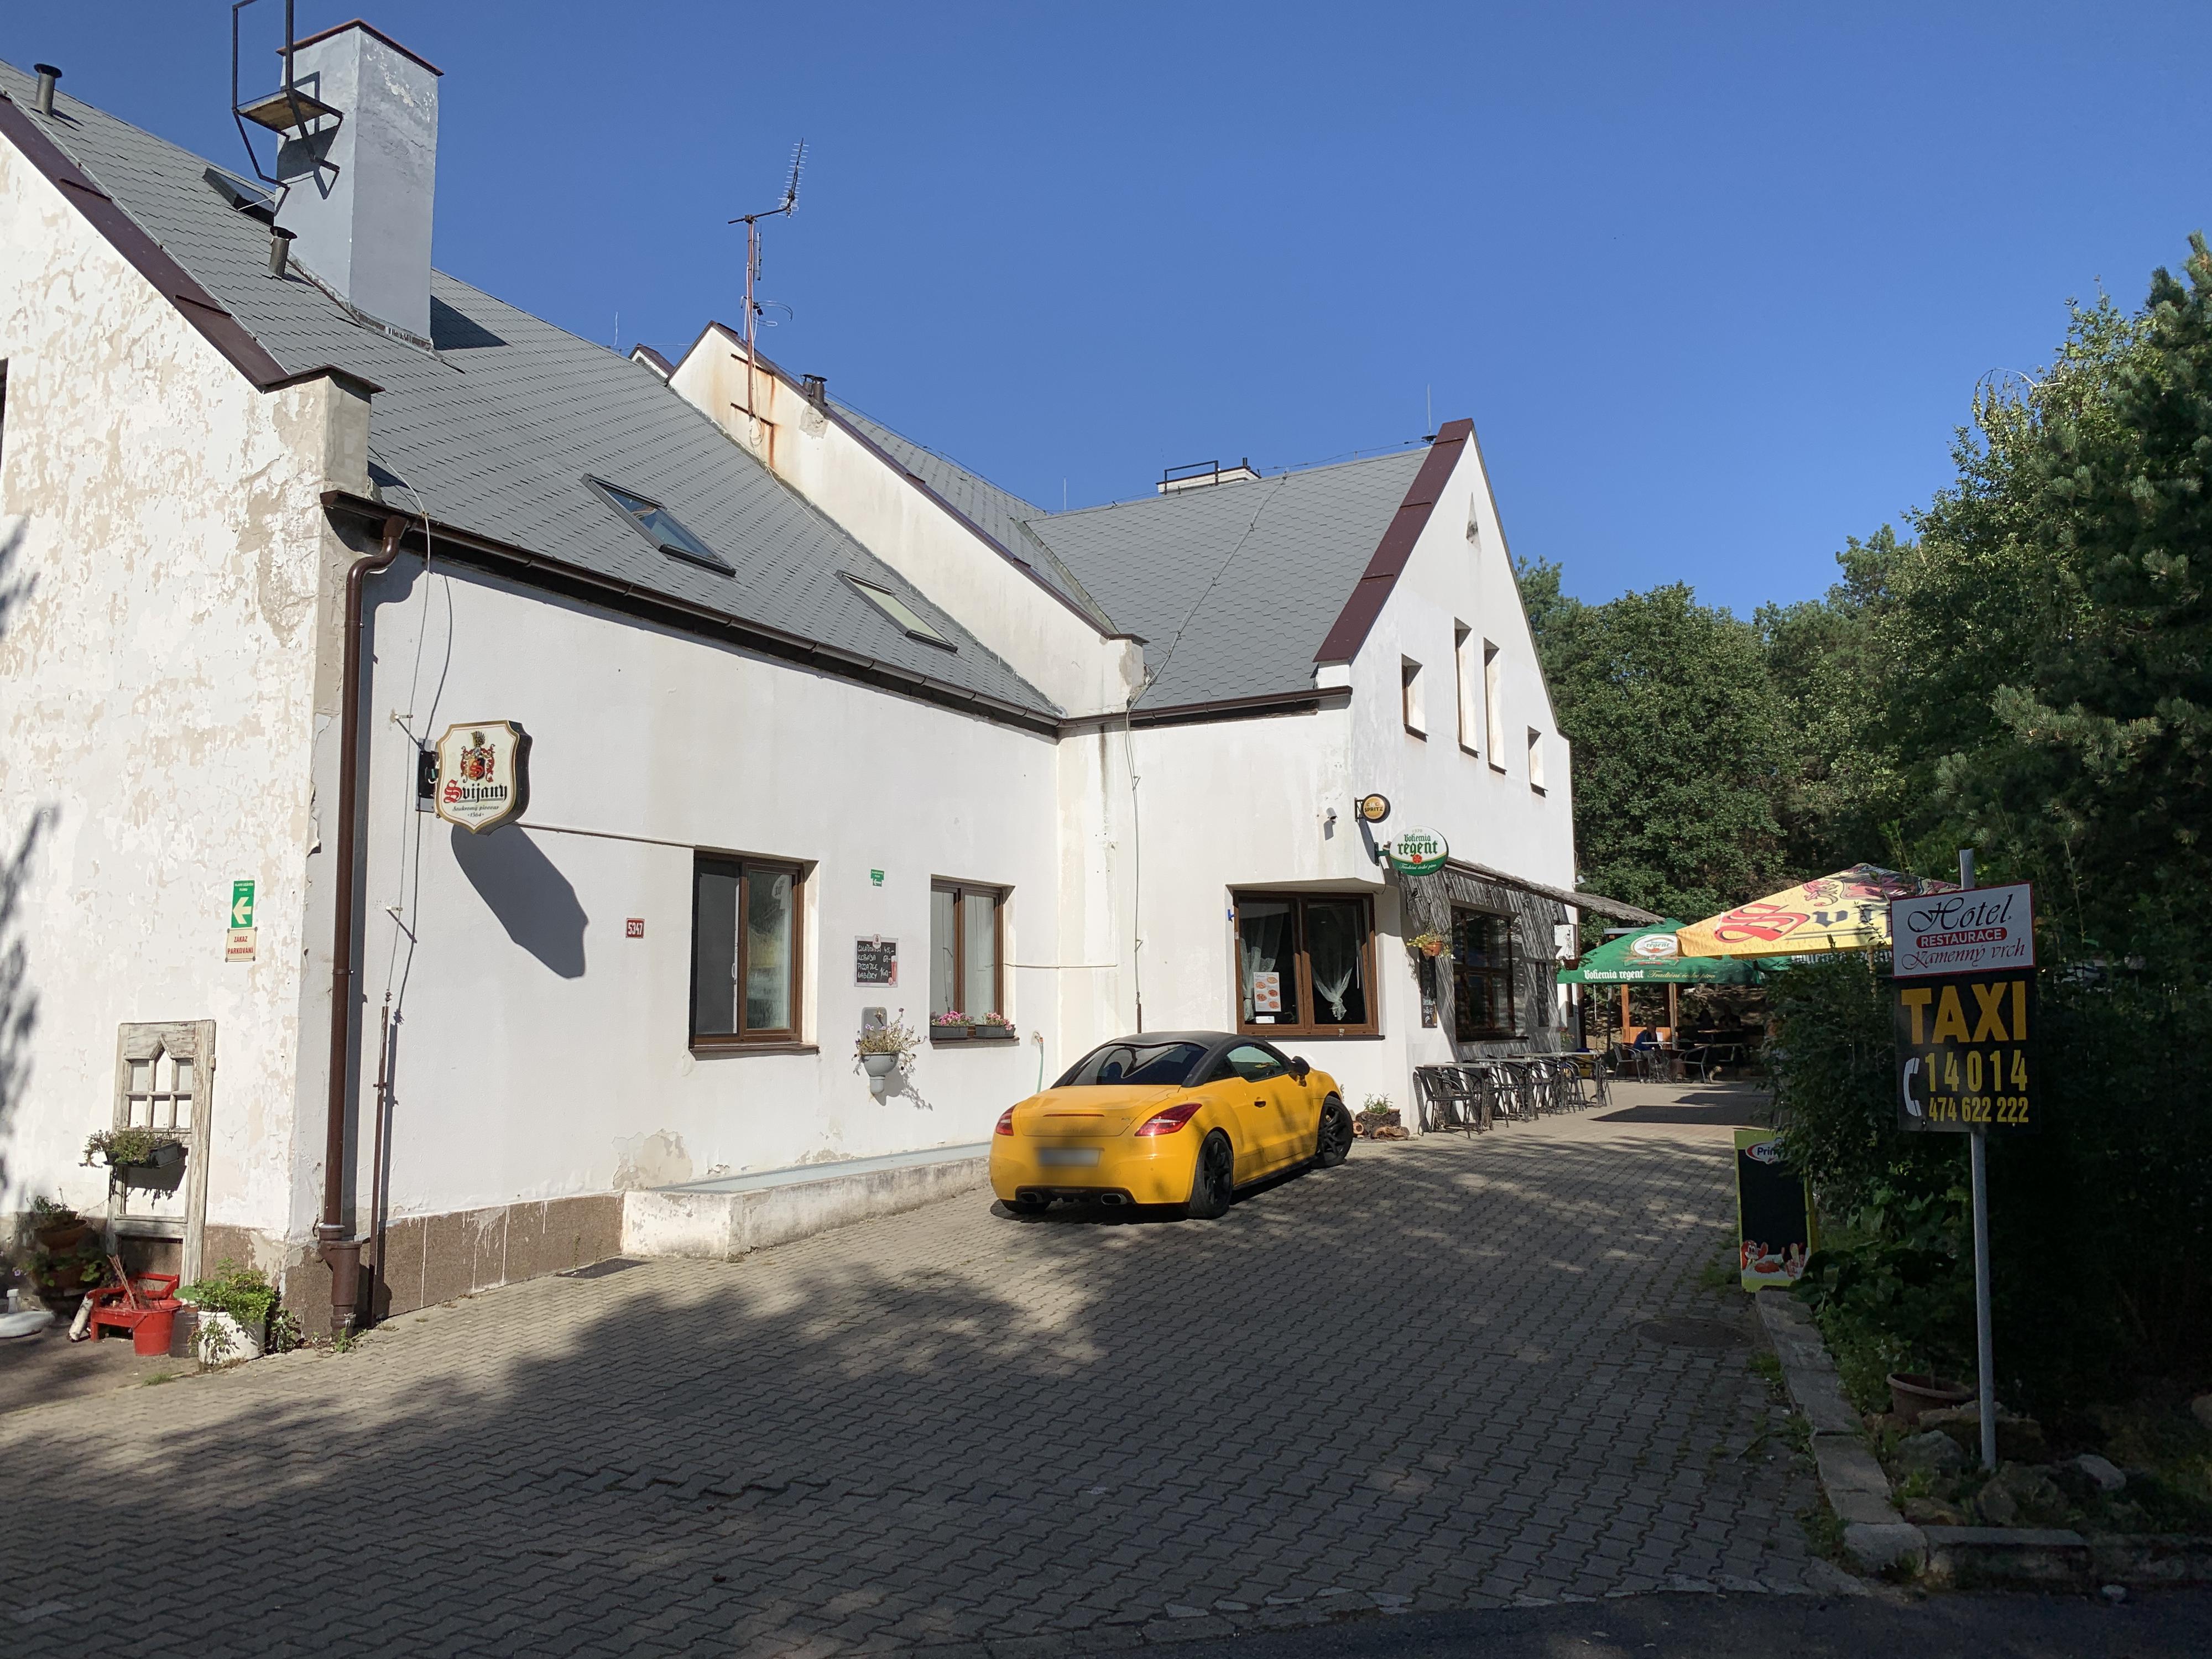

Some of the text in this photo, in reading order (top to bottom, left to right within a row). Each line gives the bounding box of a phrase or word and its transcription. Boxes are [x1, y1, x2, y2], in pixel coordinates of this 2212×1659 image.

[444, 779, 508, 803] Svijany
[1397, 841, 1438, 857] regent
[1404, 833, 1431, 842] Bohemia
[1908, 893, 2013, 933] Hotel
[628, 922, 643, 935] 5347
[1921, 928, 2002, 947] RESTAURACE
[1901, 945, 1986, 970] Kamenný
[1991, 937, 2025, 958] vrch
[1584, 969, 1617, 980] Bohemia
[1619, 969, 1644, 980] regent
[1901, 980, 2026, 1045] TAXI
[1925, 1050, 2028, 1092] 14014
[1929, 1097, 2029, 1123] 474 622 222
